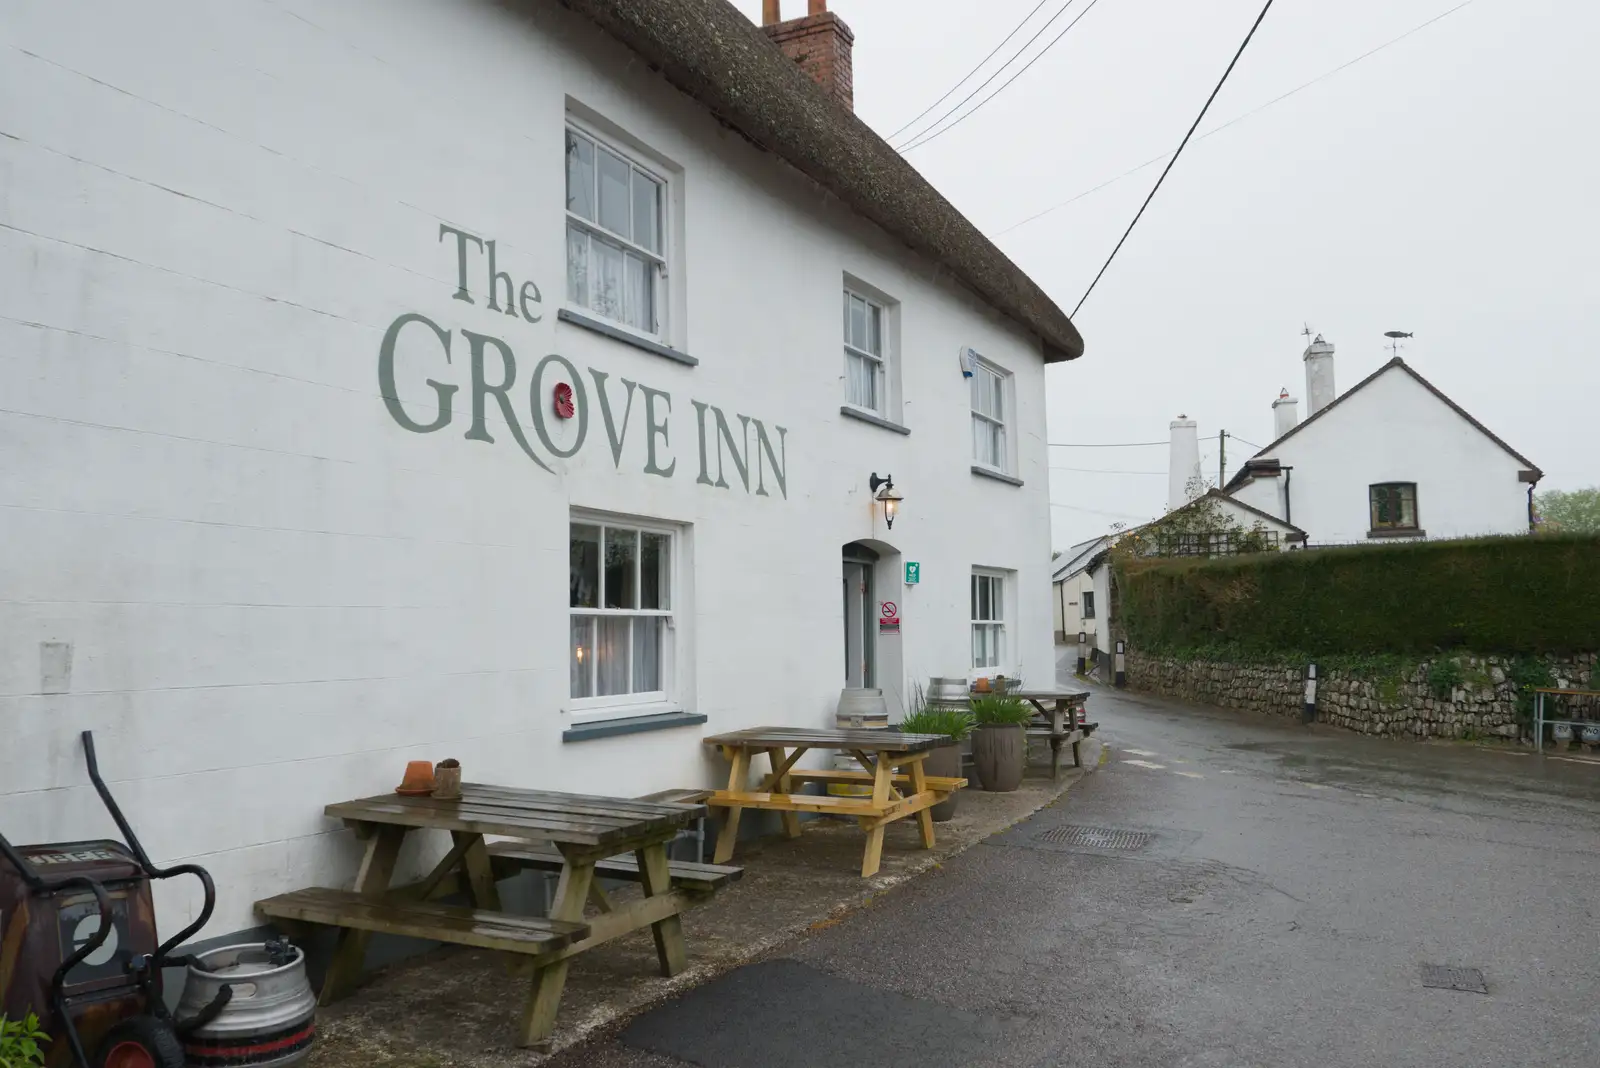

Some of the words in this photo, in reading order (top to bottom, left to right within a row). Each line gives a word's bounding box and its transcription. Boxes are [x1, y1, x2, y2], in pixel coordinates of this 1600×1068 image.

[438, 222, 543, 324] The
[377, 312, 677, 479] GROVE
[690, 398, 788, 501] INN
